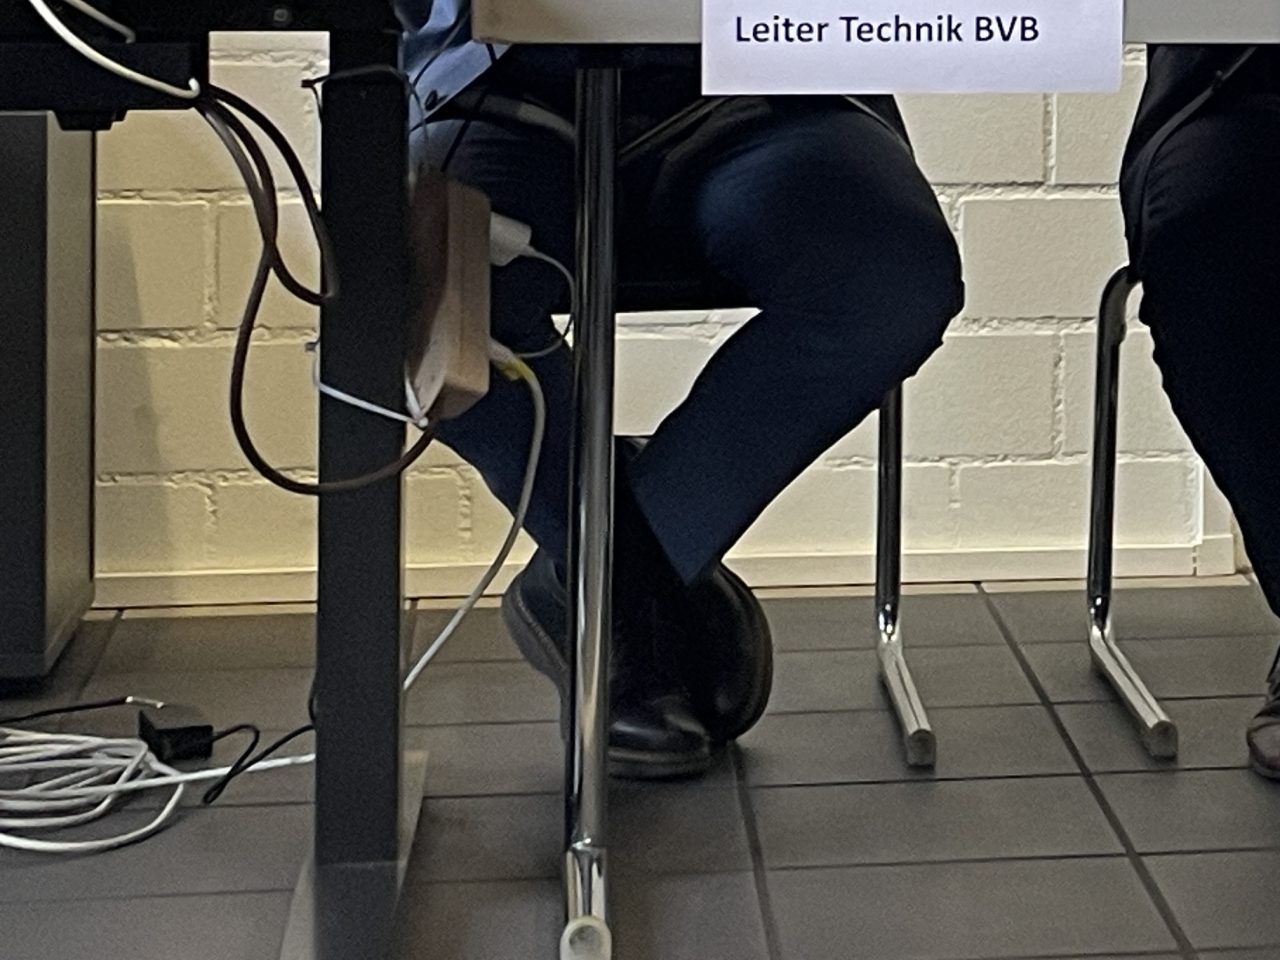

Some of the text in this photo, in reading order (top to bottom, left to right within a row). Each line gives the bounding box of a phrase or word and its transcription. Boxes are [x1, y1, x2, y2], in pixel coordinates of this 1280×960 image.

[736, 14, 1039, 43] Leiter Technik BVB
